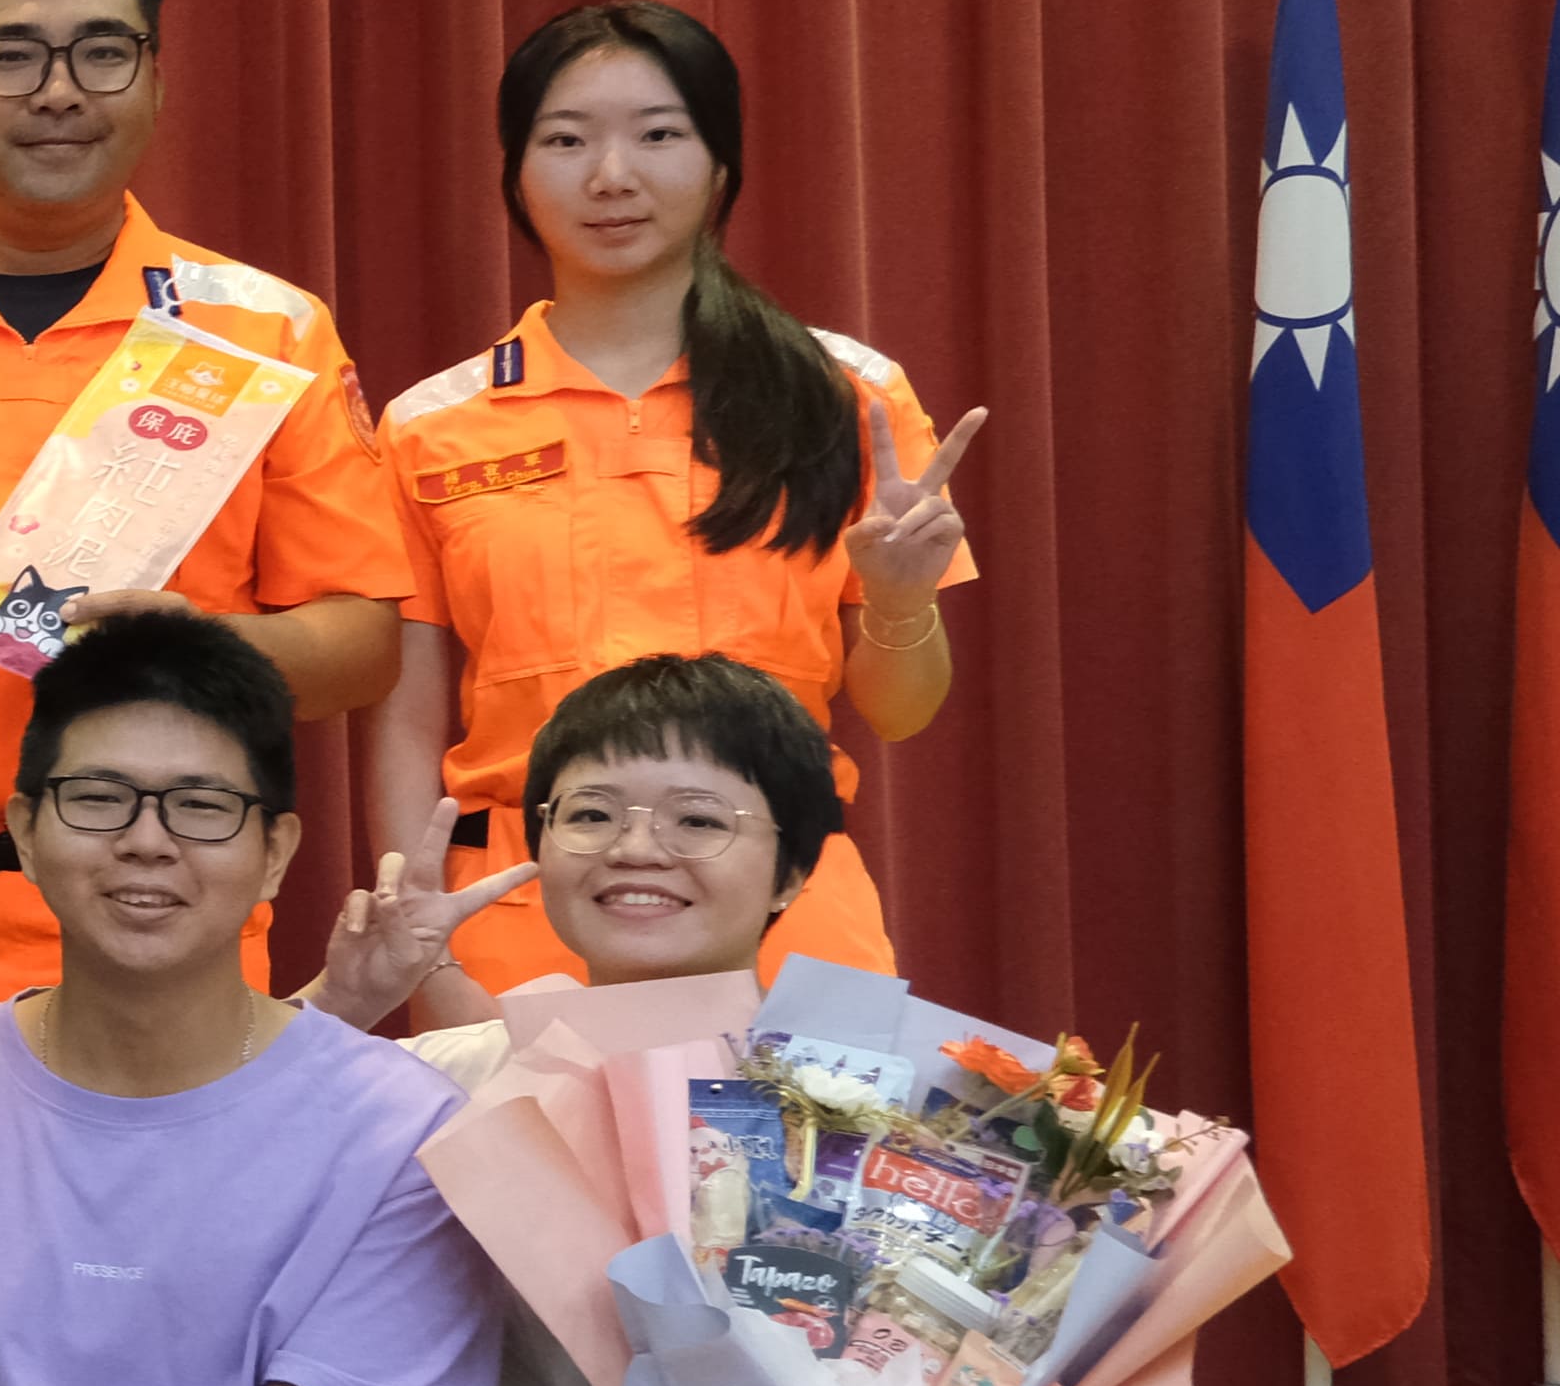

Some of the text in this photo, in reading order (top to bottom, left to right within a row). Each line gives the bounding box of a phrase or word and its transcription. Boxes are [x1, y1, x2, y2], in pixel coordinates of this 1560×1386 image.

[135, 409, 202, 446] 保庇
[41, 441, 183, 580] 純肉泥
[869, 1154, 985, 1220] hello
